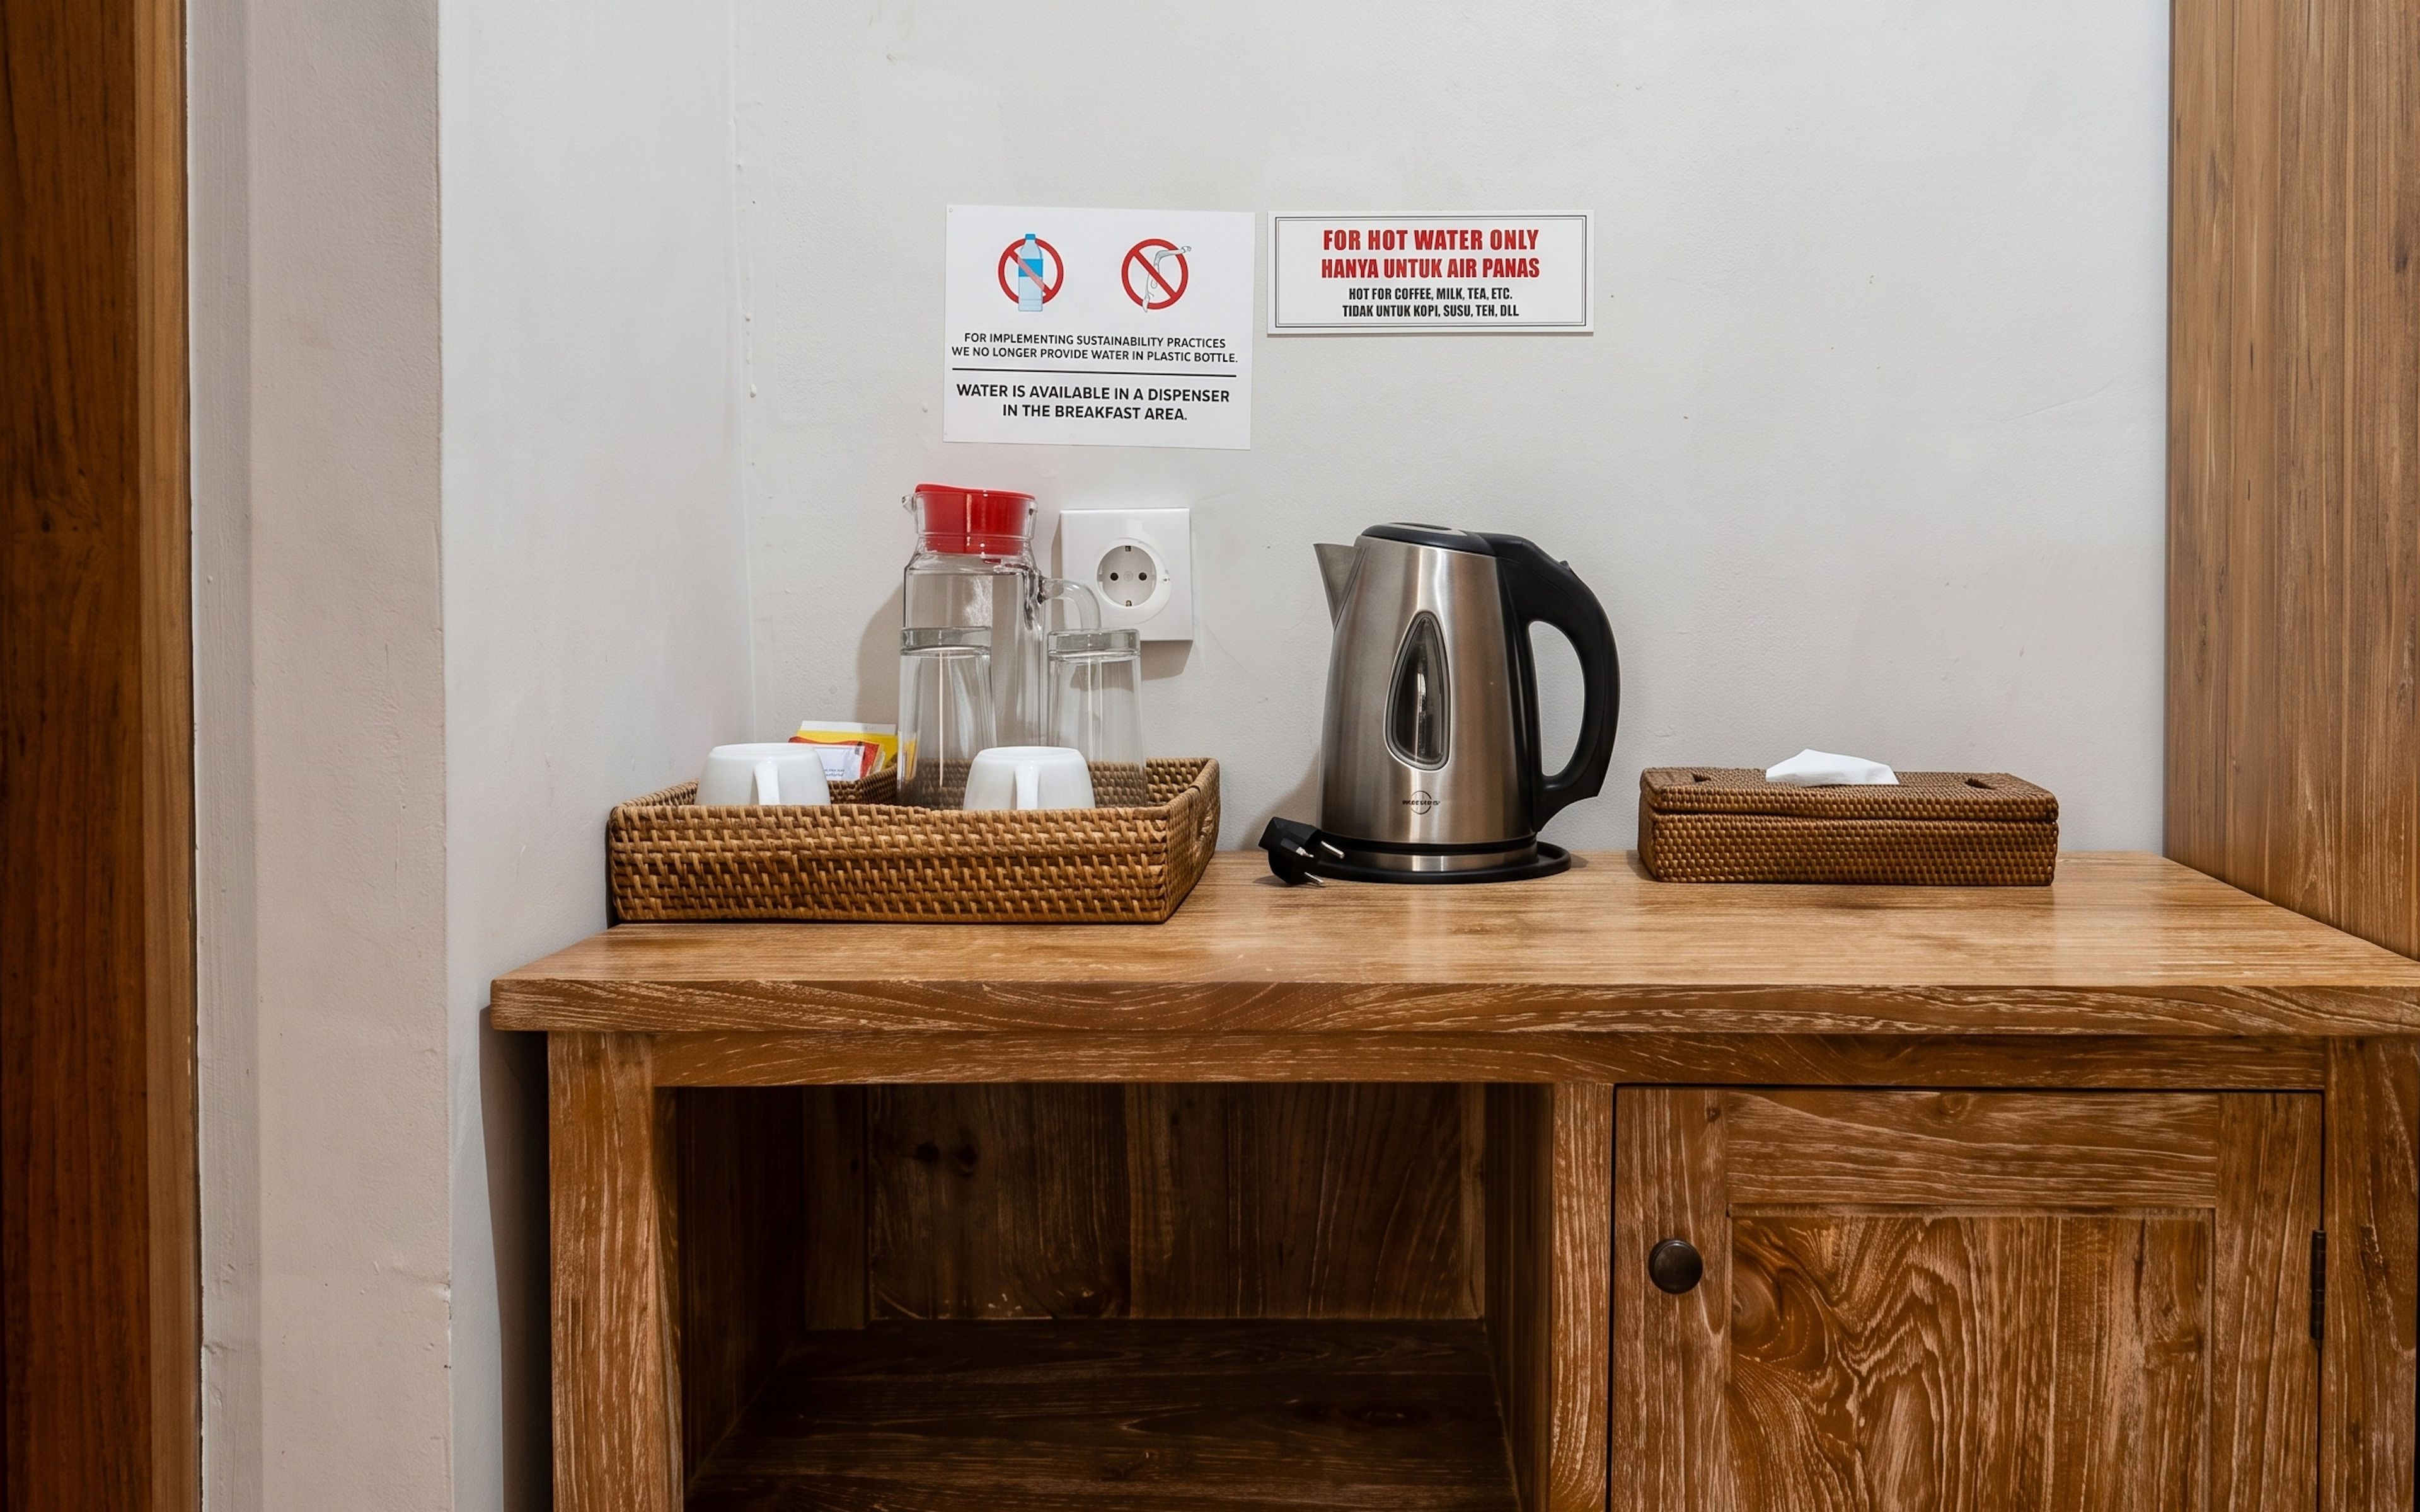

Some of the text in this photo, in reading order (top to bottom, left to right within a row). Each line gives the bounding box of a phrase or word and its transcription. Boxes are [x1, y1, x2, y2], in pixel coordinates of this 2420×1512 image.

[1323, 229, 1539, 251] FOR HOT WATER ONLY
[1322, 258, 1540, 278] HANYA UNTUK AIR PANAS
[1349, 287, 1512, 301] HOT FOR COFFEE, MILK, TEA, ETC.
[1342, 304, 1519, 318] TIDAK UNTUK KOPI, SUSU, TEH, DLL
[964, 333, 1226, 348] FOR IMPLEMENTING SUSTAINABILITY PRACTICES
[951, 346, 1238, 363] WE NO LONGER PROVIDE WATER IN PLASTIC BOTTLE.
[956, 384, 1230, 403] WATER IS AVAILABLE IN A DISPENSER
[1003, 404, 1187, 421] IN THE BREAKFAST AREA.
